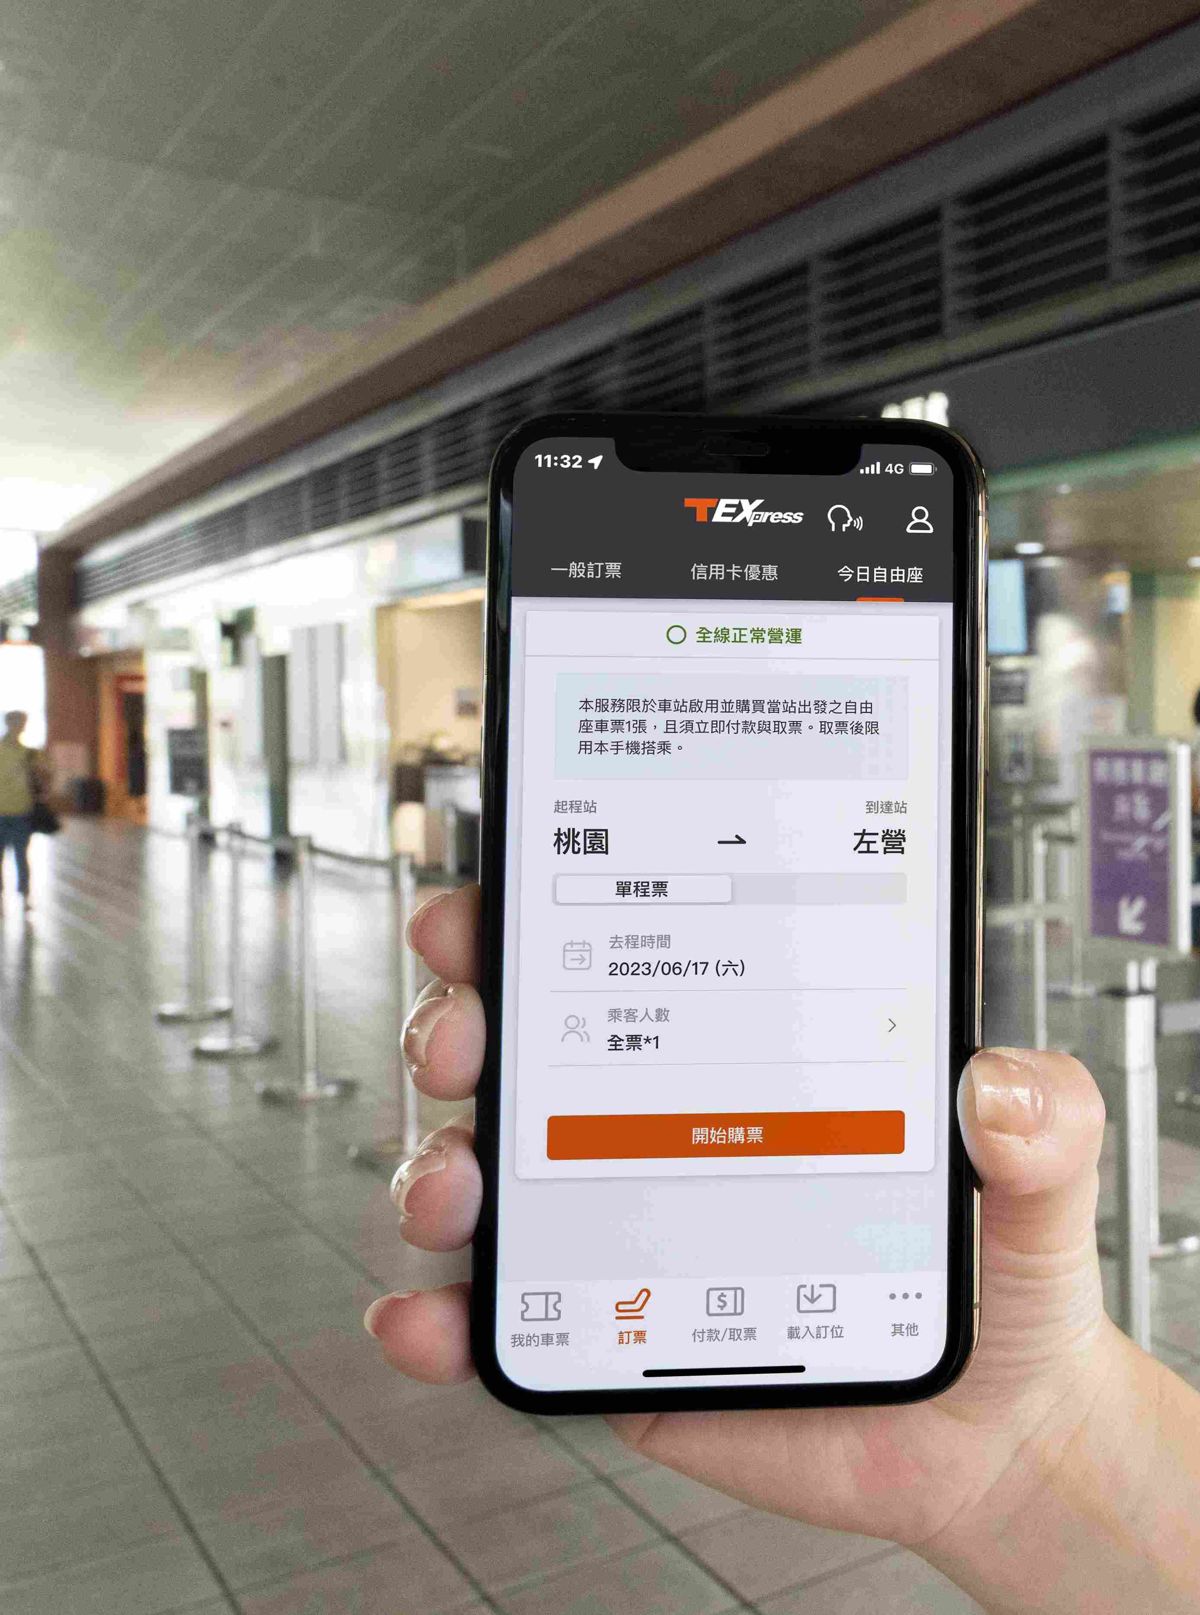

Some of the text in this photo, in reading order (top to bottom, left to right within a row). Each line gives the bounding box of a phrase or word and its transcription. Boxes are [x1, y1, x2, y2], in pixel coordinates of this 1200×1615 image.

[534, 454, 583, 469] 11:32
[884, 463, 905, 475] 4G
[684, 498, 805, 527] TEXpress
[550, 560, 622, 579] 一般訂票
[690, 562, 779, 582] 信用卡優惠
[837, 565, 924, 584] 今日自由座
[695, 626, 803, 645] 全線正常營運
[577, 740, 684, 757] 用本手機搭乘。
[553, 799, 598, 814] 起程站
[865, 800, 908, 815] 到達站
[552, 827, 609, 856] 桃園
[852, 828, 907, 855] 左營
[615, 880, 669, 898] 單程票
[608, 934, 671, 950] 去程時間
[608, 960, 745, 978] 2023/06/17 (六)
[607, 1007, 671, 1024] 乘客人數
[691, 1126, 764, 1145] 開始購票
[617, 1330, 647, 1345] 訂票
[691, 1327, 758, 1343] 付款/取票
[786, 1324, 845, 1341] 載入訂位
[890, 1322, 920, 1338] 其他
[510, 1332, 570, 1348] 我的車票
